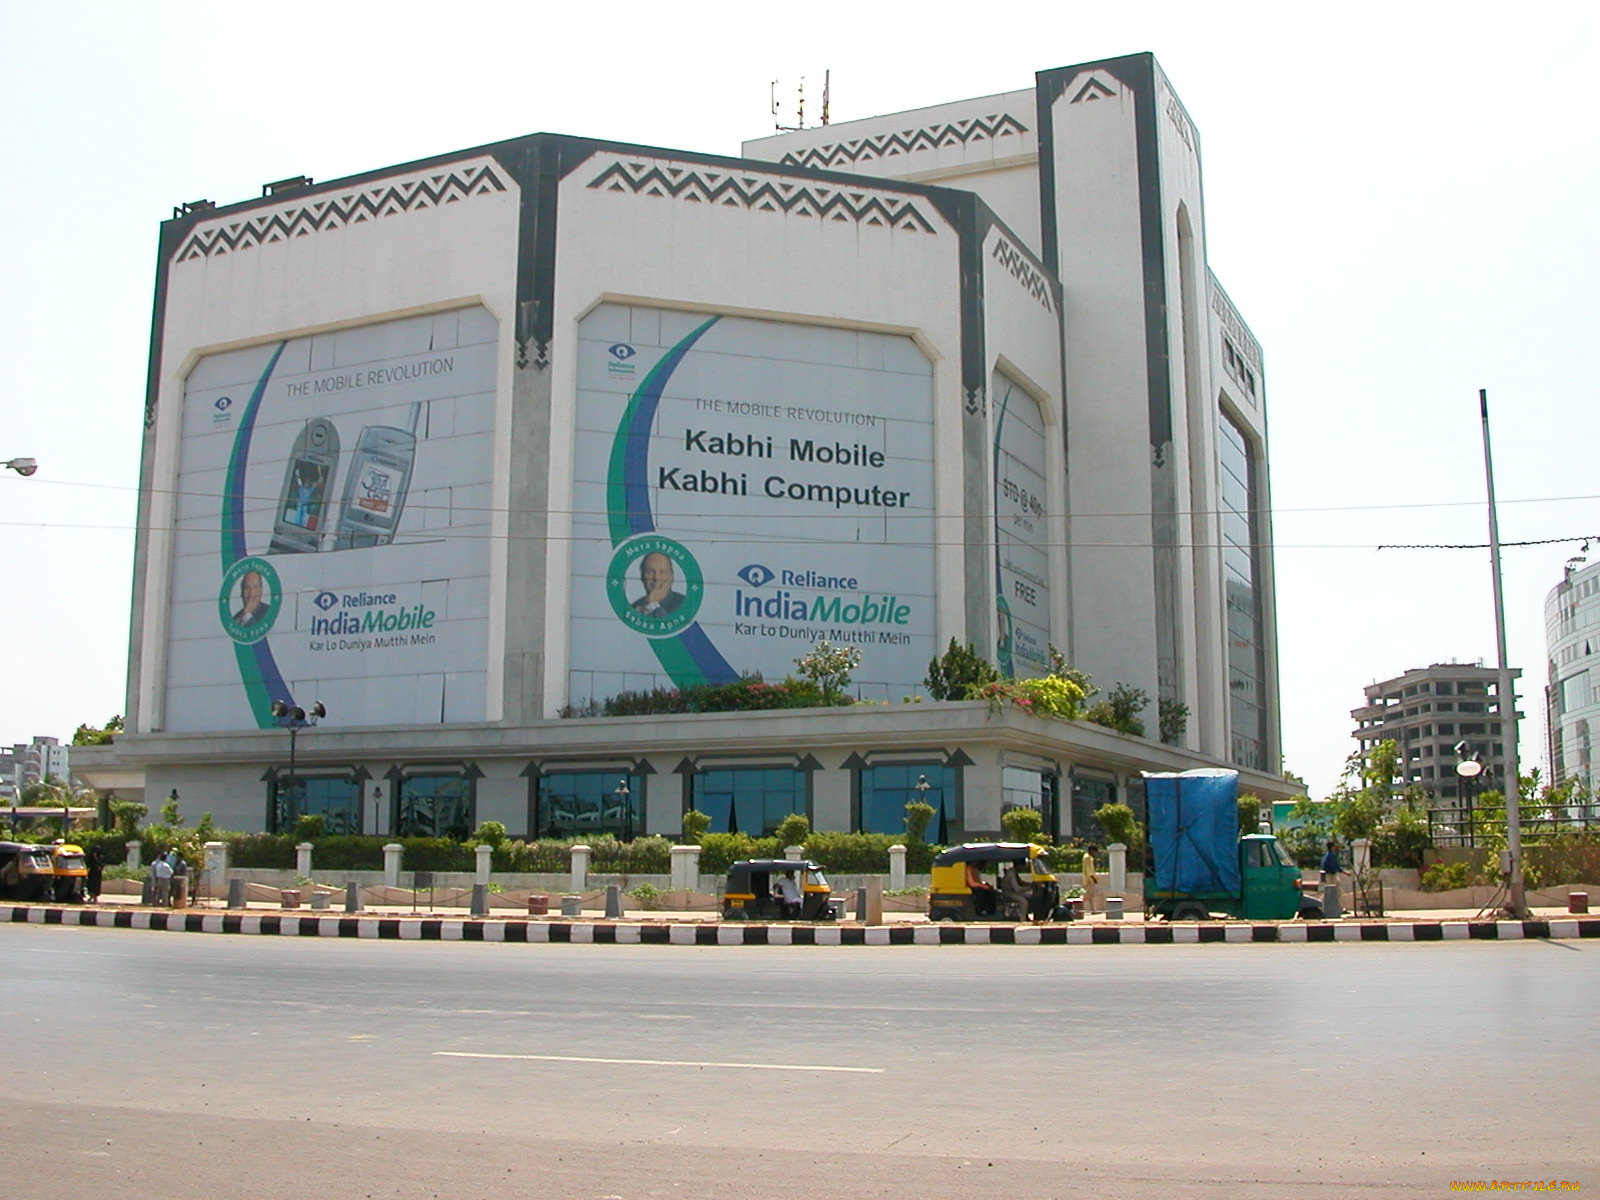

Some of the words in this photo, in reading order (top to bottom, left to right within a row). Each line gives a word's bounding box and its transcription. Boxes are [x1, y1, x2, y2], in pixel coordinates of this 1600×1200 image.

[286, 381, 310, 397] THE
[313, 372, 363, 393] MOBILE
[367, 357, 454, 385] REVOLUTION
[695, 398, 721, 412] THE
[727, 401, 782, 418] MOBILE
[787, 407, 876, 427] REVOLUTION
[685, 429, 773, 459] Kabhi
[790, 438, 885, 468] Mobile
[659, 467, 748, 496] Kabhi
[764, 475, 910, 508] Computer
[625, 542, 651, 557] Mera
[655, 541, 685, 560] Sapna
[782, 569, 858, 590] Reliance
[342, 592, 397, 608] Reliance
[736, 589, 911, 625] IndiaMobile
[1015, 580, 1036, 607] FREE
[310, 603, 436, 636] IndiaMobile
[624, 610, 654, 630] Sabka
[660, 614, 685, 630] Apna
[309, 640, 324, 651] Kar
[326, 640, 337, 650] Lo
[339, 639, 372, 652] Duniya
[374, 634, 408, 648] Mutthi
[410, 633, 436, 645] Mein
[735, 622, 757, 635] Kar
[761, 624, 776, 637] Lo
[779, 625, 825, 643] Duniya
[829, 629, 875, 643] Mutthi
[878, 632, 911, 645] Mein
